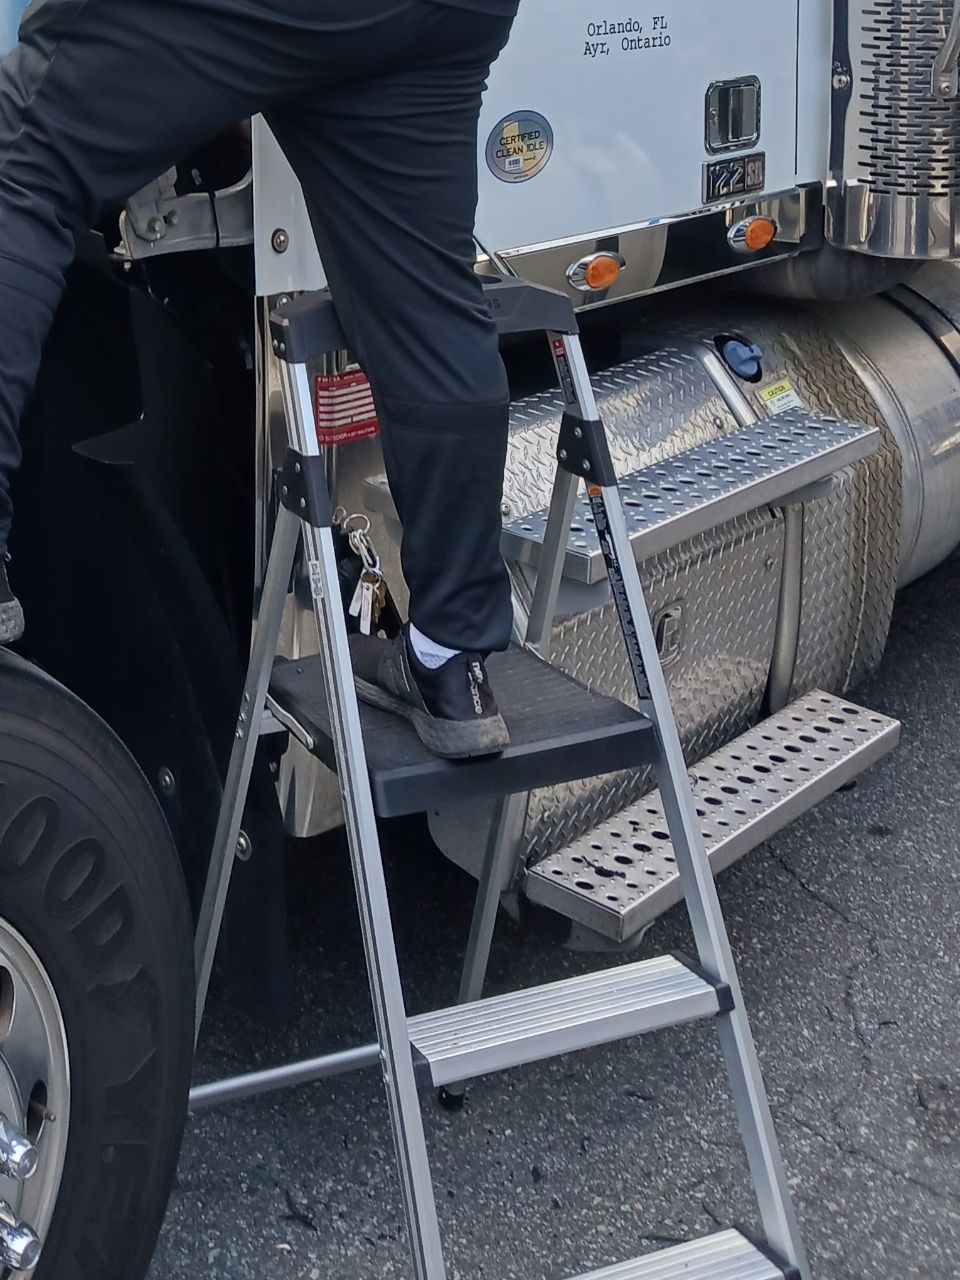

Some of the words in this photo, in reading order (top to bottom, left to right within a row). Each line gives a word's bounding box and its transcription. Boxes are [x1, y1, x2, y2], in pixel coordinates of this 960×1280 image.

[587, 17, 643, 37] Orlando,
[652, 16, 668, 31] FL
[583, 41, 610, 58] Ayr,
[621, 31, 671, 51] Ontario
[499, 130, 541, 146] CERTIFIED
[495, 145, 524, 159] CLEAN
[526, 140, 545, 153] IDLE
